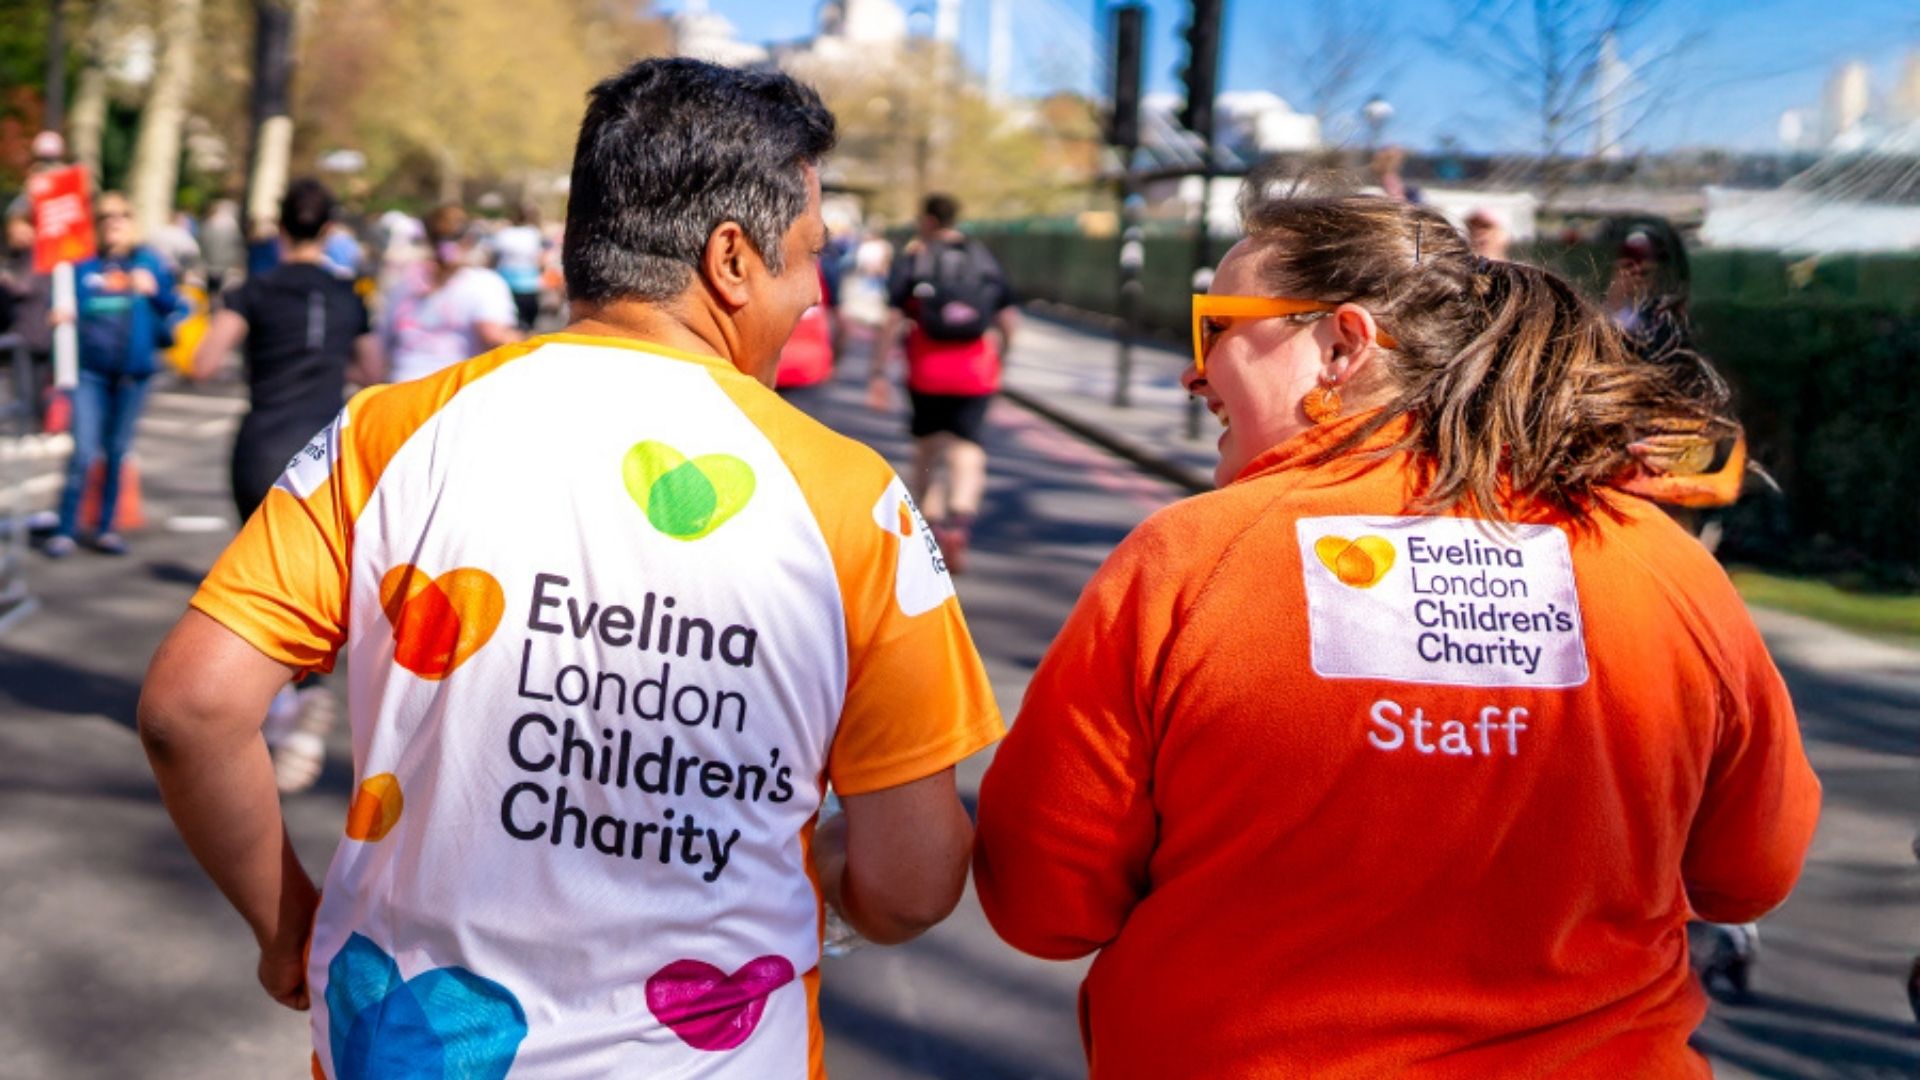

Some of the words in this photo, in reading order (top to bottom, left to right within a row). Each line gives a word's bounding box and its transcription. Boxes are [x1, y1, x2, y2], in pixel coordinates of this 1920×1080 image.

[1407, 536, 1524, 568] Evelina
[1411, 567, 1528, 598] London
[527, 573, 758, 668] Evelina
[1414, 599, 1574, 632] Children's
[1417, 631, 1542, 675] Charity
[518, 638, 747, 732] London
[1367, 698, 1530, 756] Staff
[508, 712, 793, 802] Children's
[501, 781, 740, 882] Charity
